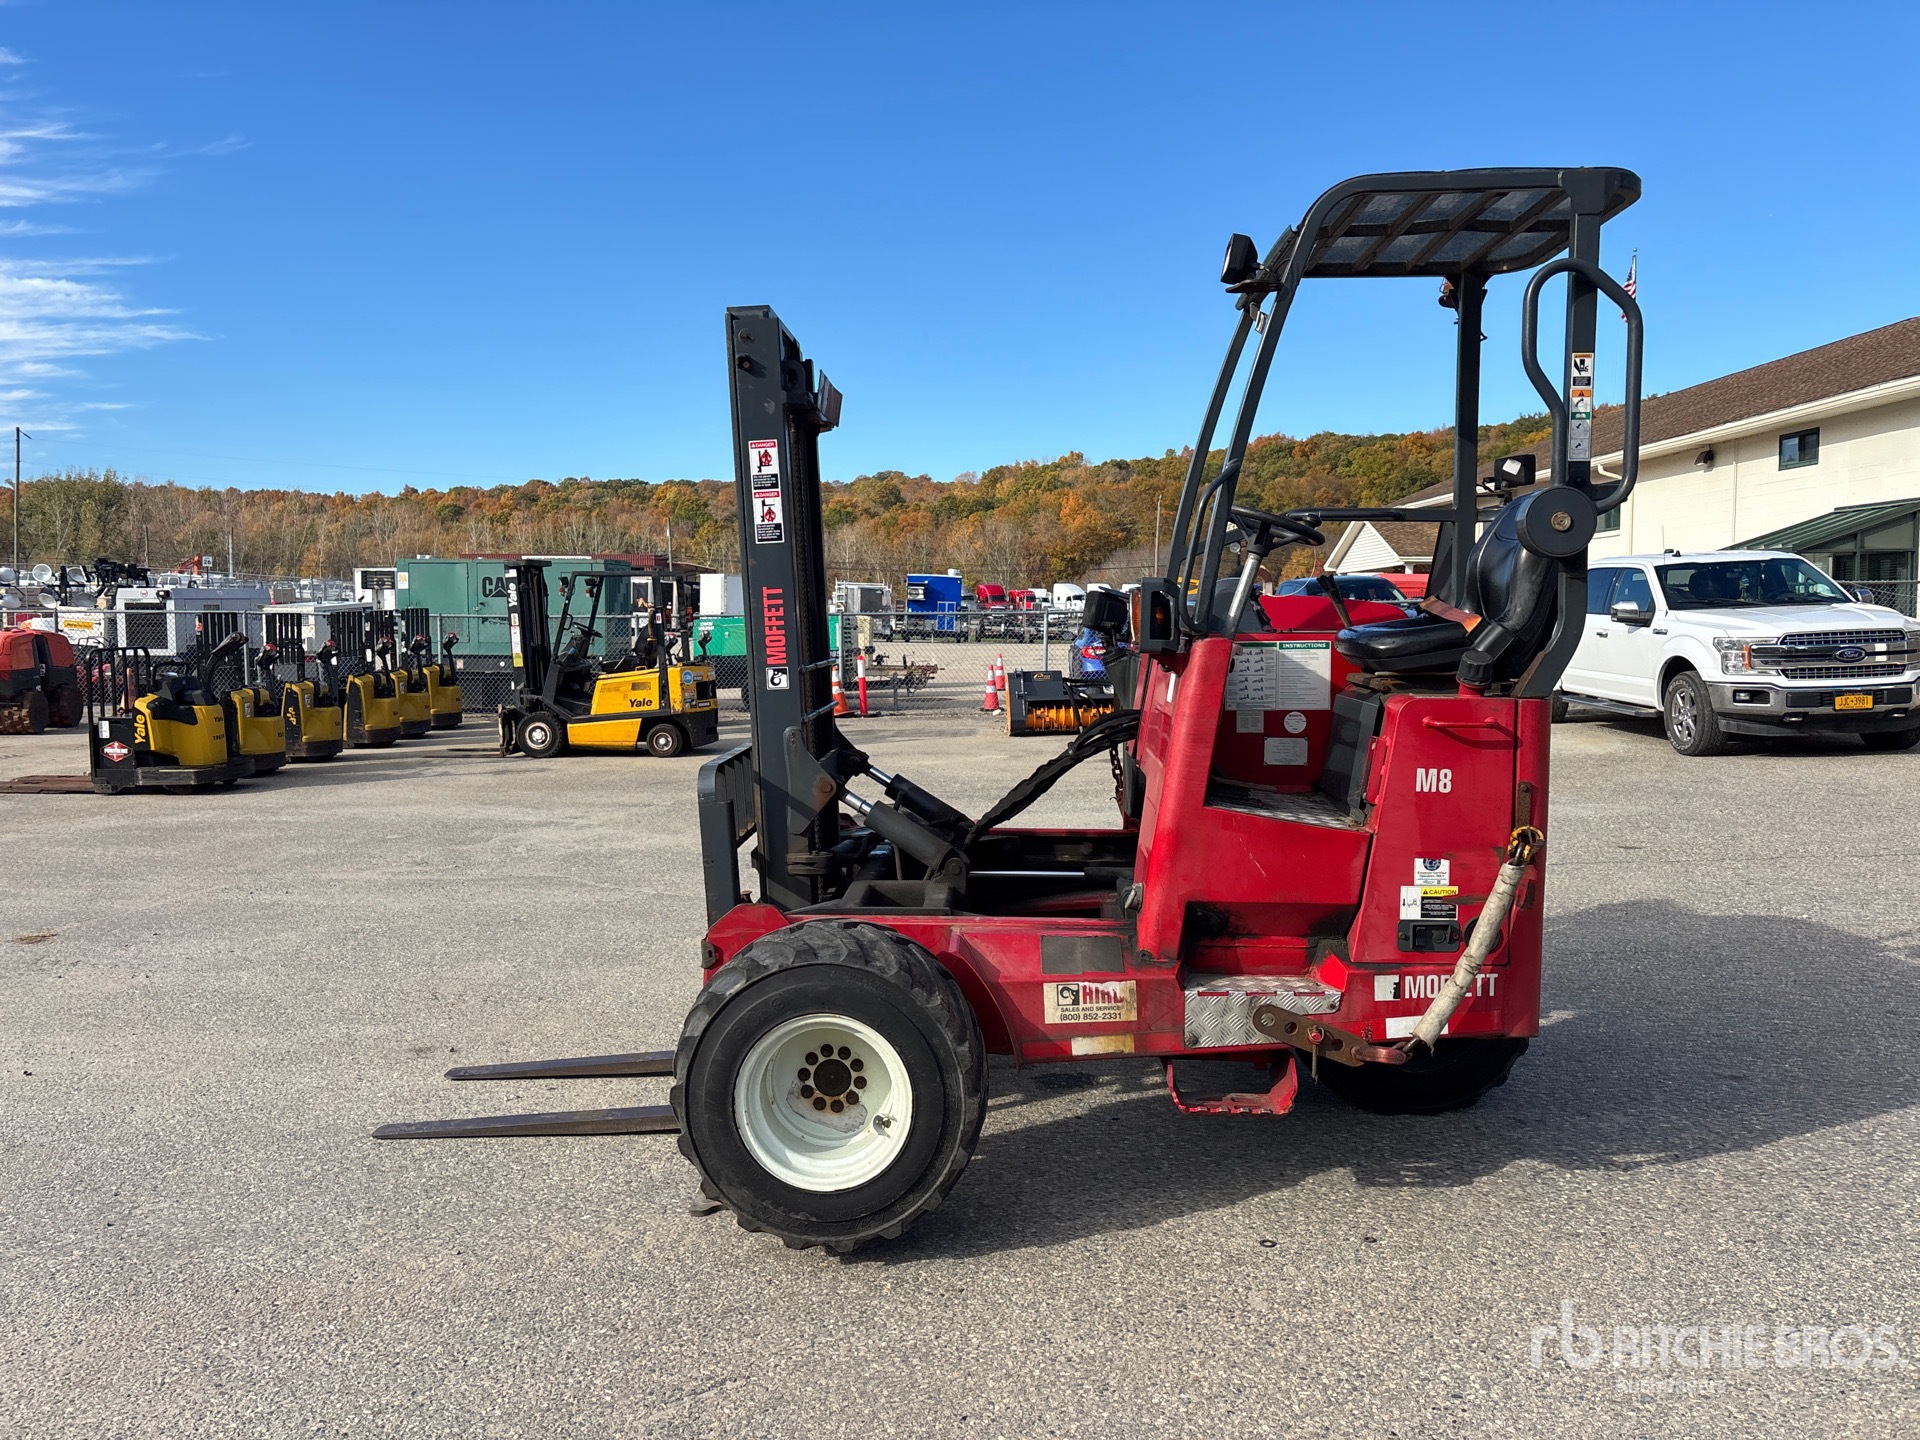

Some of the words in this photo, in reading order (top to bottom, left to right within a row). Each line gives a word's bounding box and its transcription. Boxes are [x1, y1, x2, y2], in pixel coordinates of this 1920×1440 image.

[508, 582, 518, 608] Yale
[762, 586, 787, 665] MOFFETT
[629, 697, 653, 708] Yale
[133, 713, 146, 744] Yale
[1415, 767, 1452, 794] M8
[1060, 1012, 1081, 1022] (800)
[1082, 1011, 1122, 1021] 852-2331
